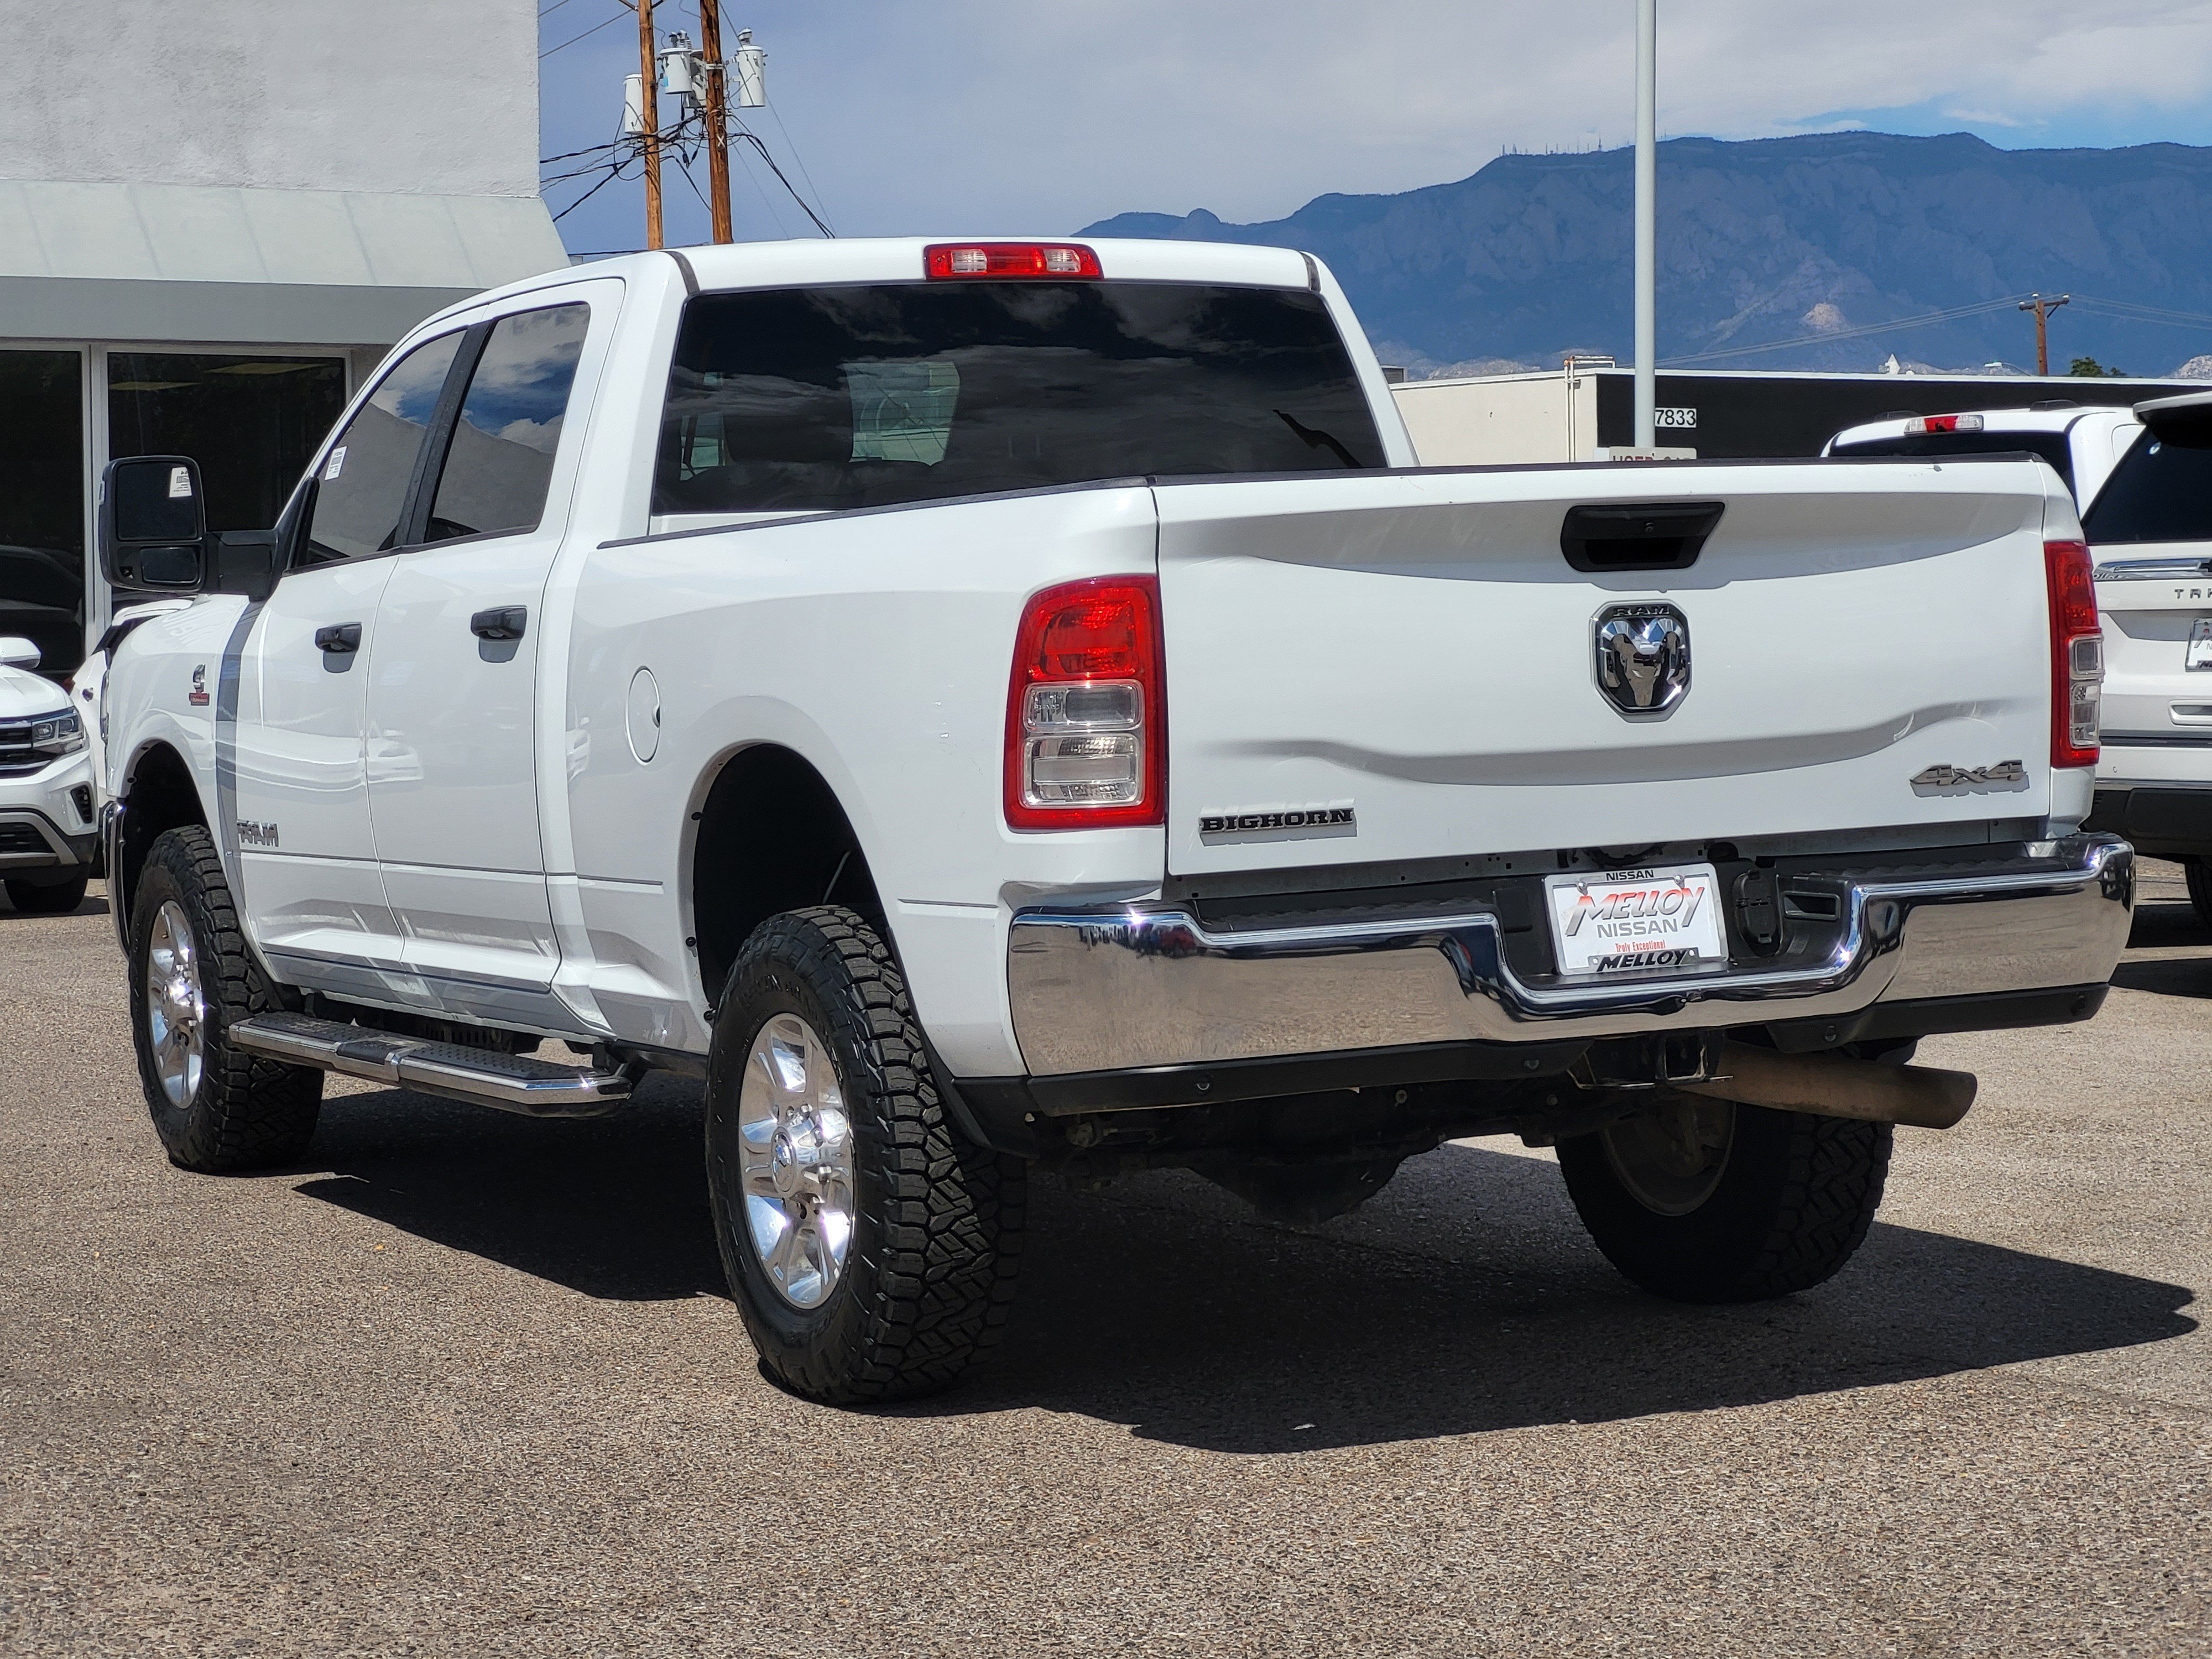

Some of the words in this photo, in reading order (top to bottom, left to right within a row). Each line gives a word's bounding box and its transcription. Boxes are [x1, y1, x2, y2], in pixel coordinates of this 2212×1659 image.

[1655, 409, 1696, 426] 7833
[1613, 606, 1670, 617] RAM
[1198, 807, 1355, 833] BIGHORN
[1606, 869, 1655, 881] NISSAN
[1564, 886, 1705, 937] MELLOY
[1597, 918, 1678, 938] NISSAN
[1615, 942, 1631, 953] Truly
[1632, 939, 1666, 951] Exceptional
[1596, 949, 1688, 972] MELLOY
